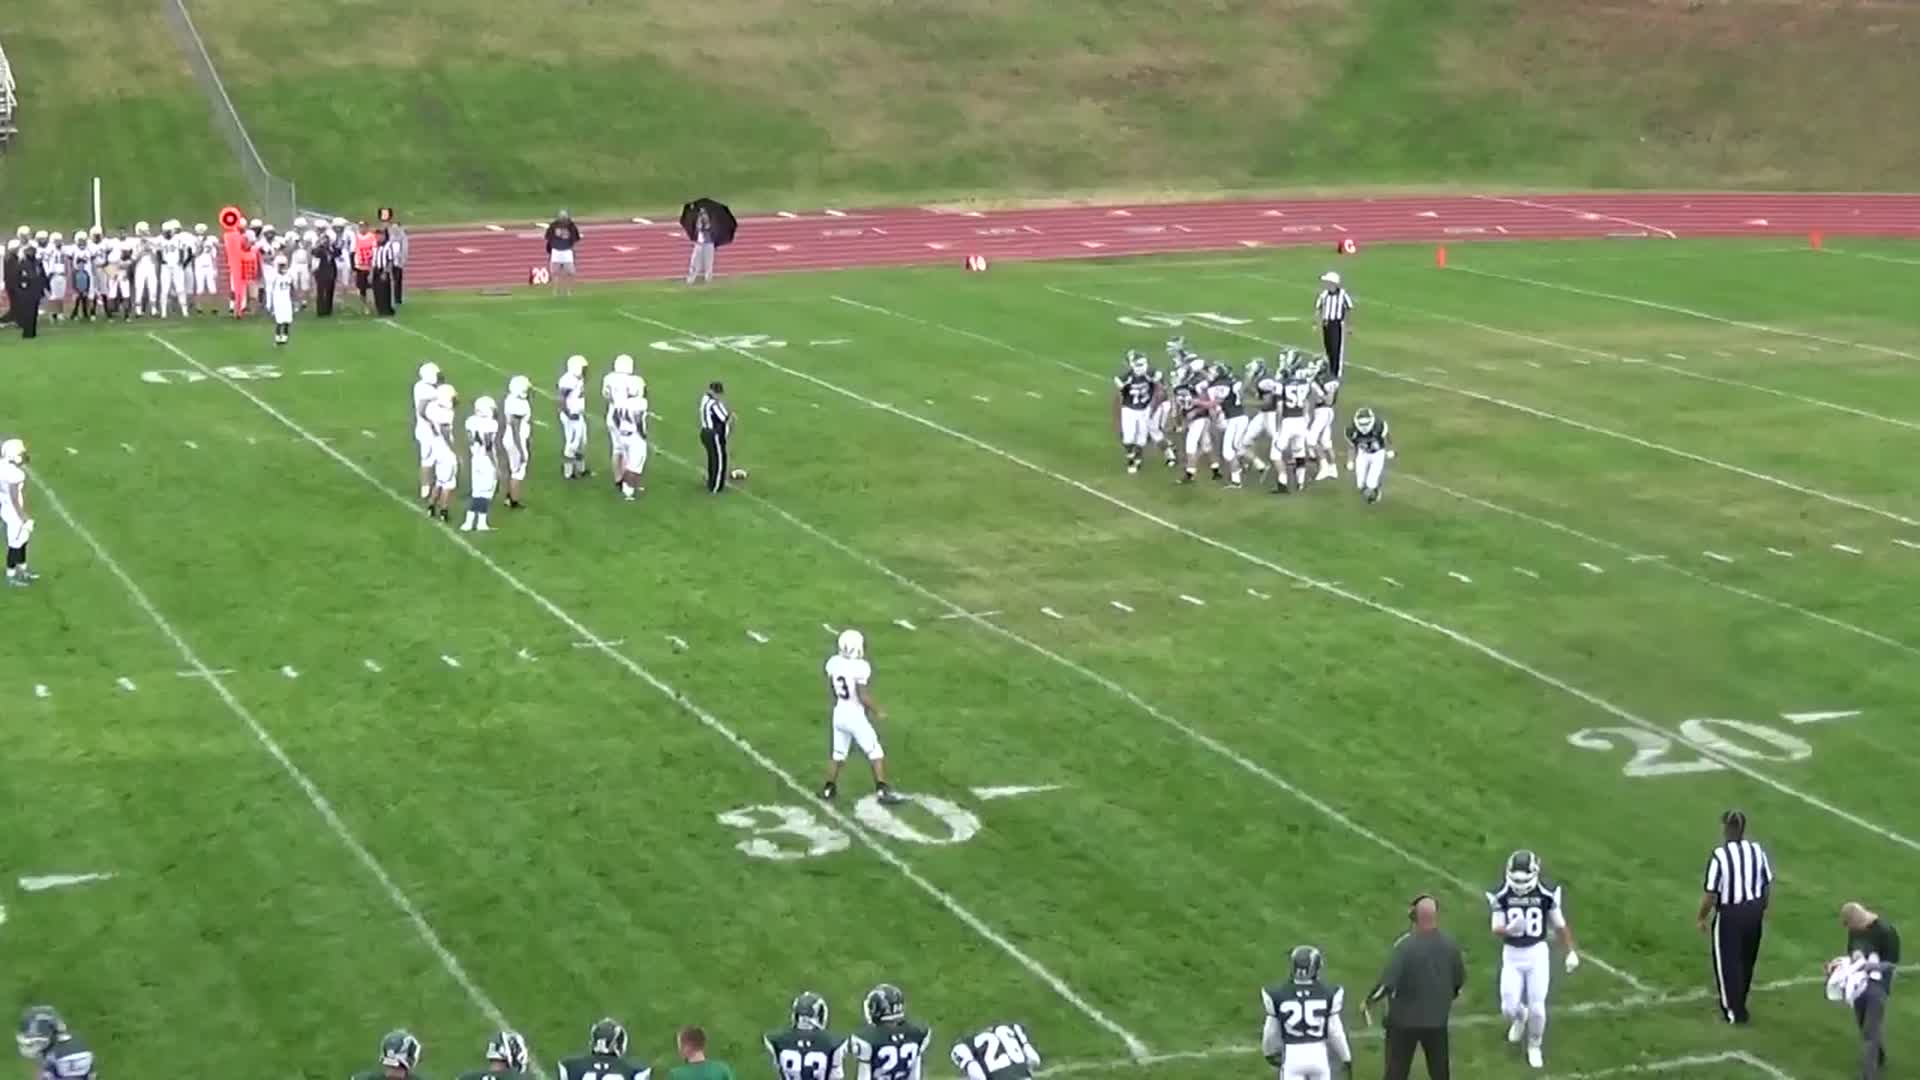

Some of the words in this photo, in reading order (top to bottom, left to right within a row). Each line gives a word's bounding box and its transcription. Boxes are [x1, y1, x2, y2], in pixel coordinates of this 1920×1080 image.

[532, 267, 550, 285] 20
[1566, 718, 1812, 777] 20
[716, 792, 982, 860] 30
[1279, 999, 1327, 1038] 25
[974, 1025, 1022, 1073] 26
